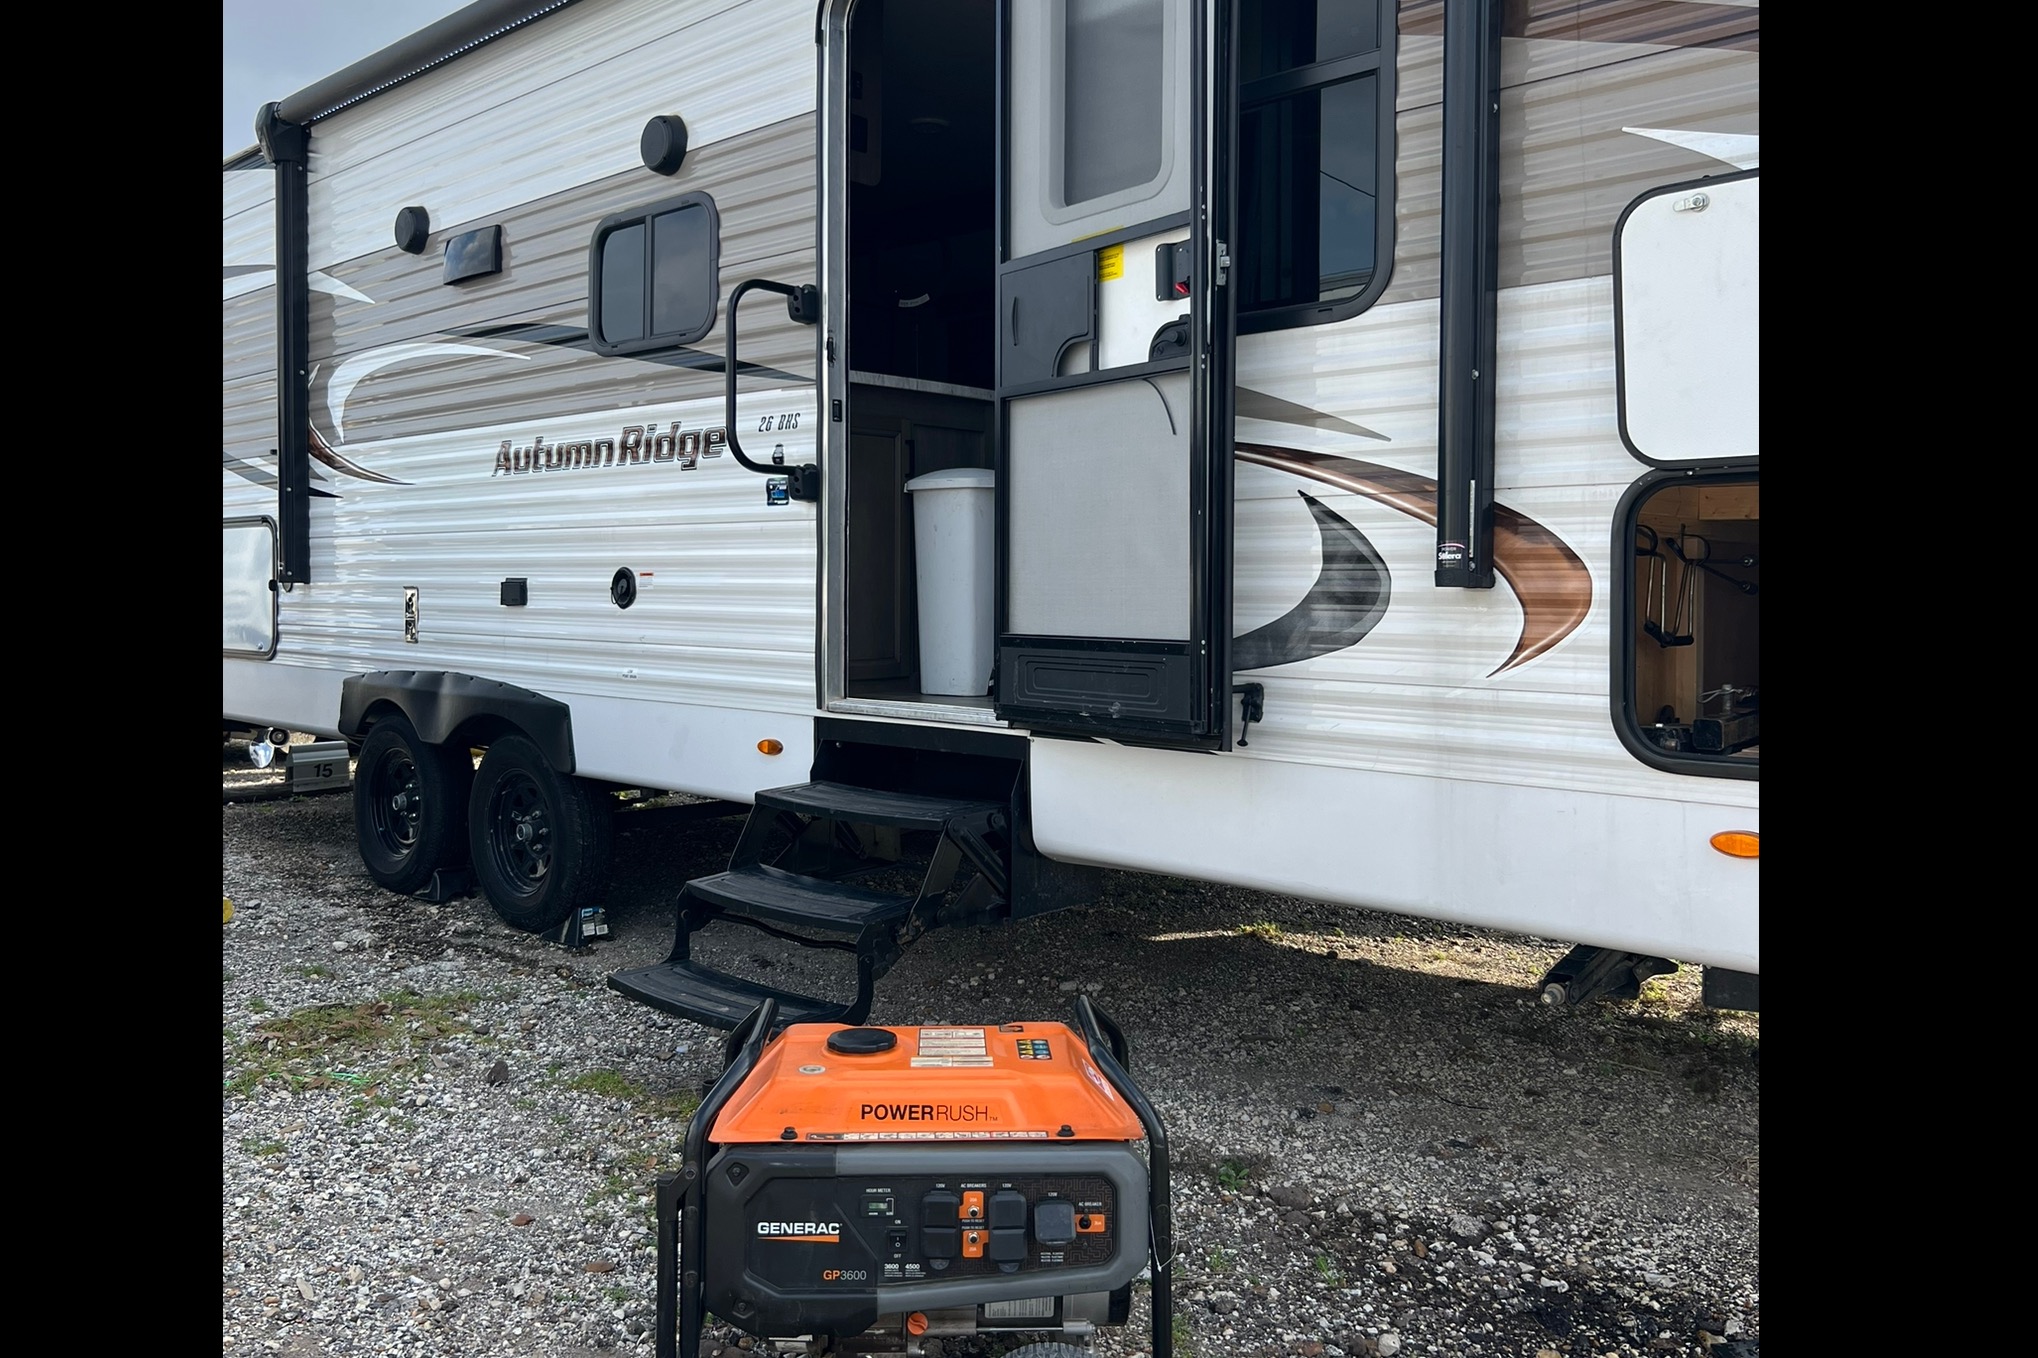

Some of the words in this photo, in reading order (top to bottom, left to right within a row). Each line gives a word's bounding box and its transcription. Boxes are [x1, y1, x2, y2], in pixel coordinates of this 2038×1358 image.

[758, 415, 774, 432] 26
[777, 412, 801, 431] BHS
[313, 763, 333, 778] 15
[757, 1222, 840, 1235] GENERAC
[823, 1270, 867, 1281] GP3600
